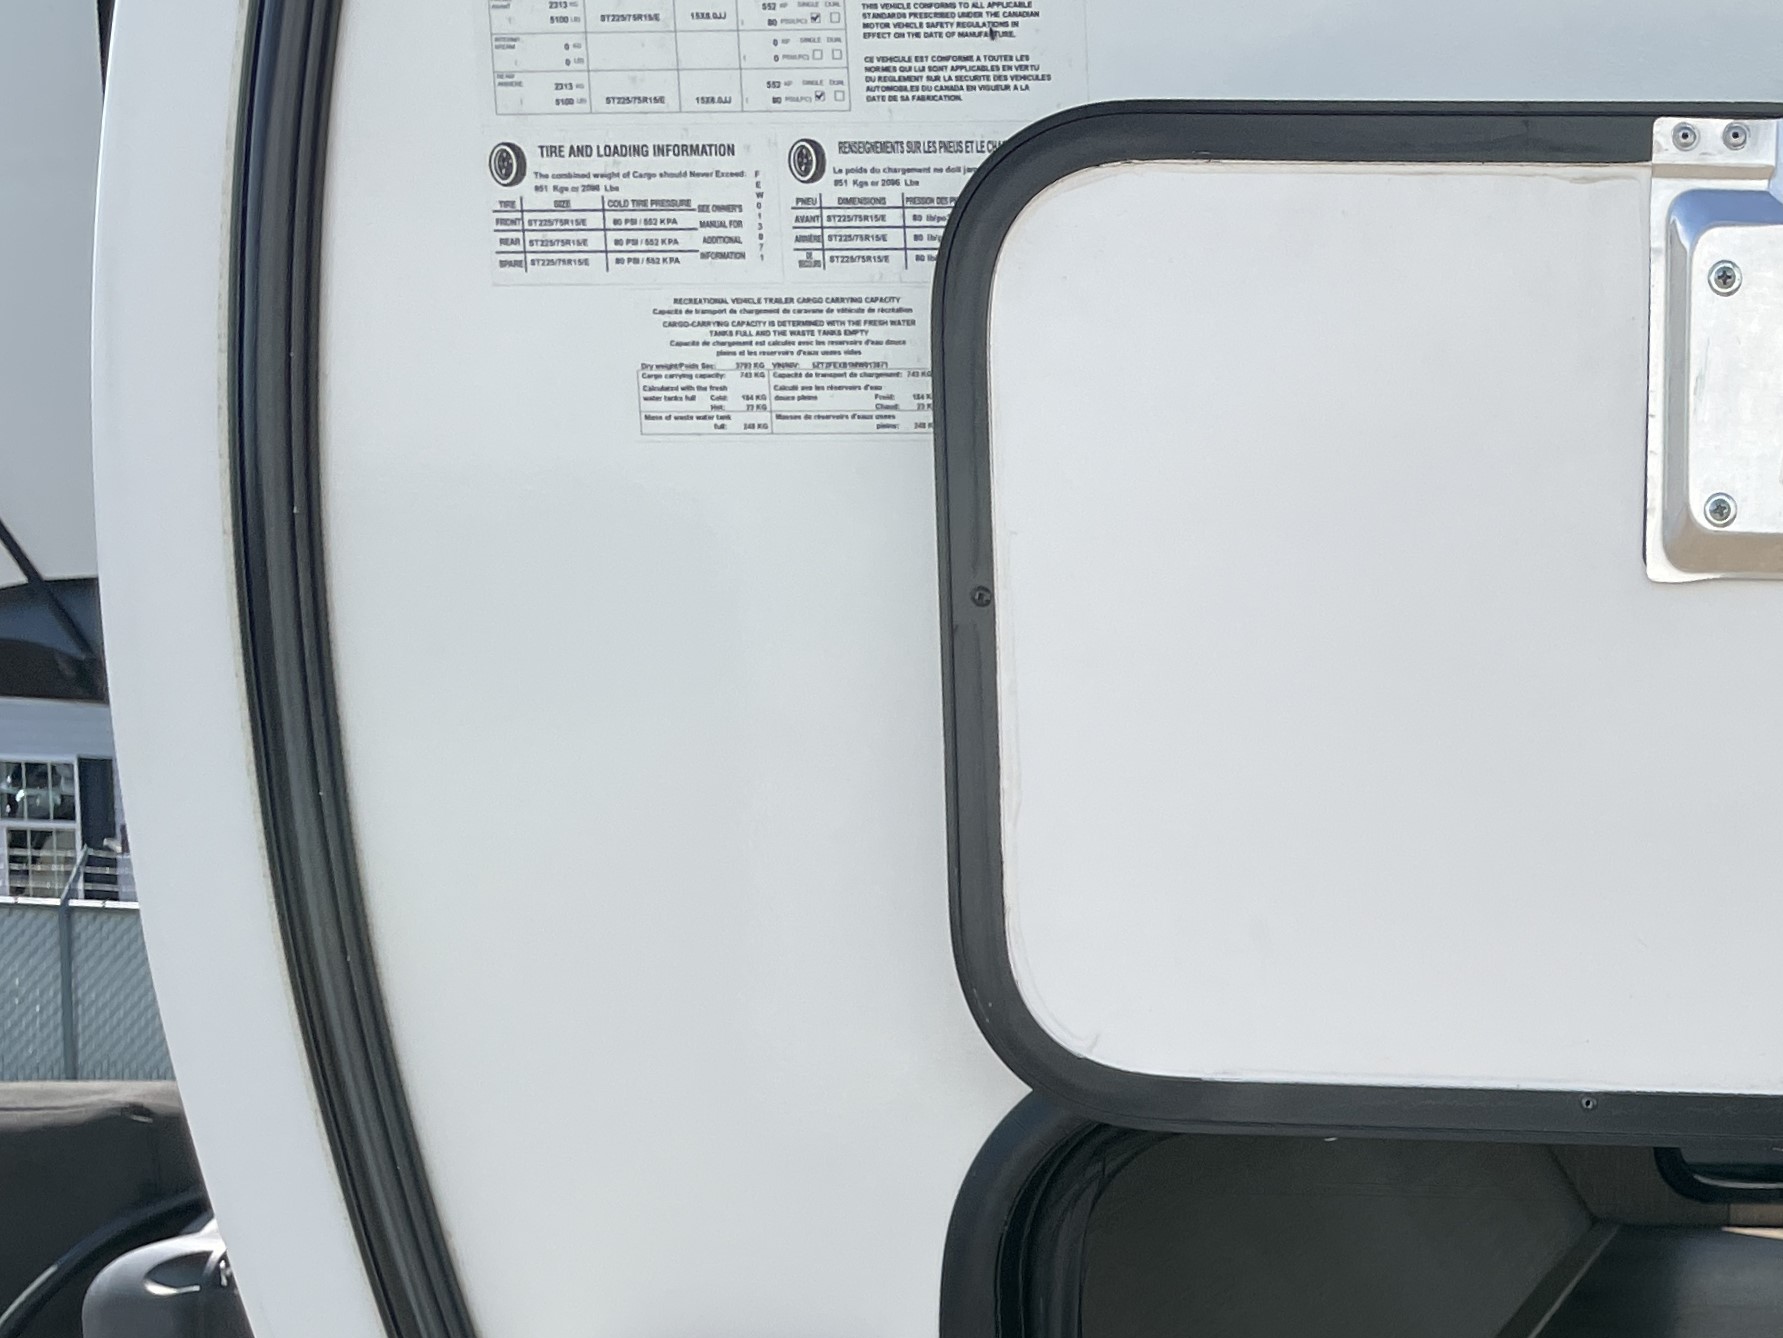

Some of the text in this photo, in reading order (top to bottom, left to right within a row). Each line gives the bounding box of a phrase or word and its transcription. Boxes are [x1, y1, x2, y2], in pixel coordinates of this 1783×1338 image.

[538, 144, 735, 158] TIRE AND LOADING INFORMATION
[631, 200, 648, 208] TIRE
